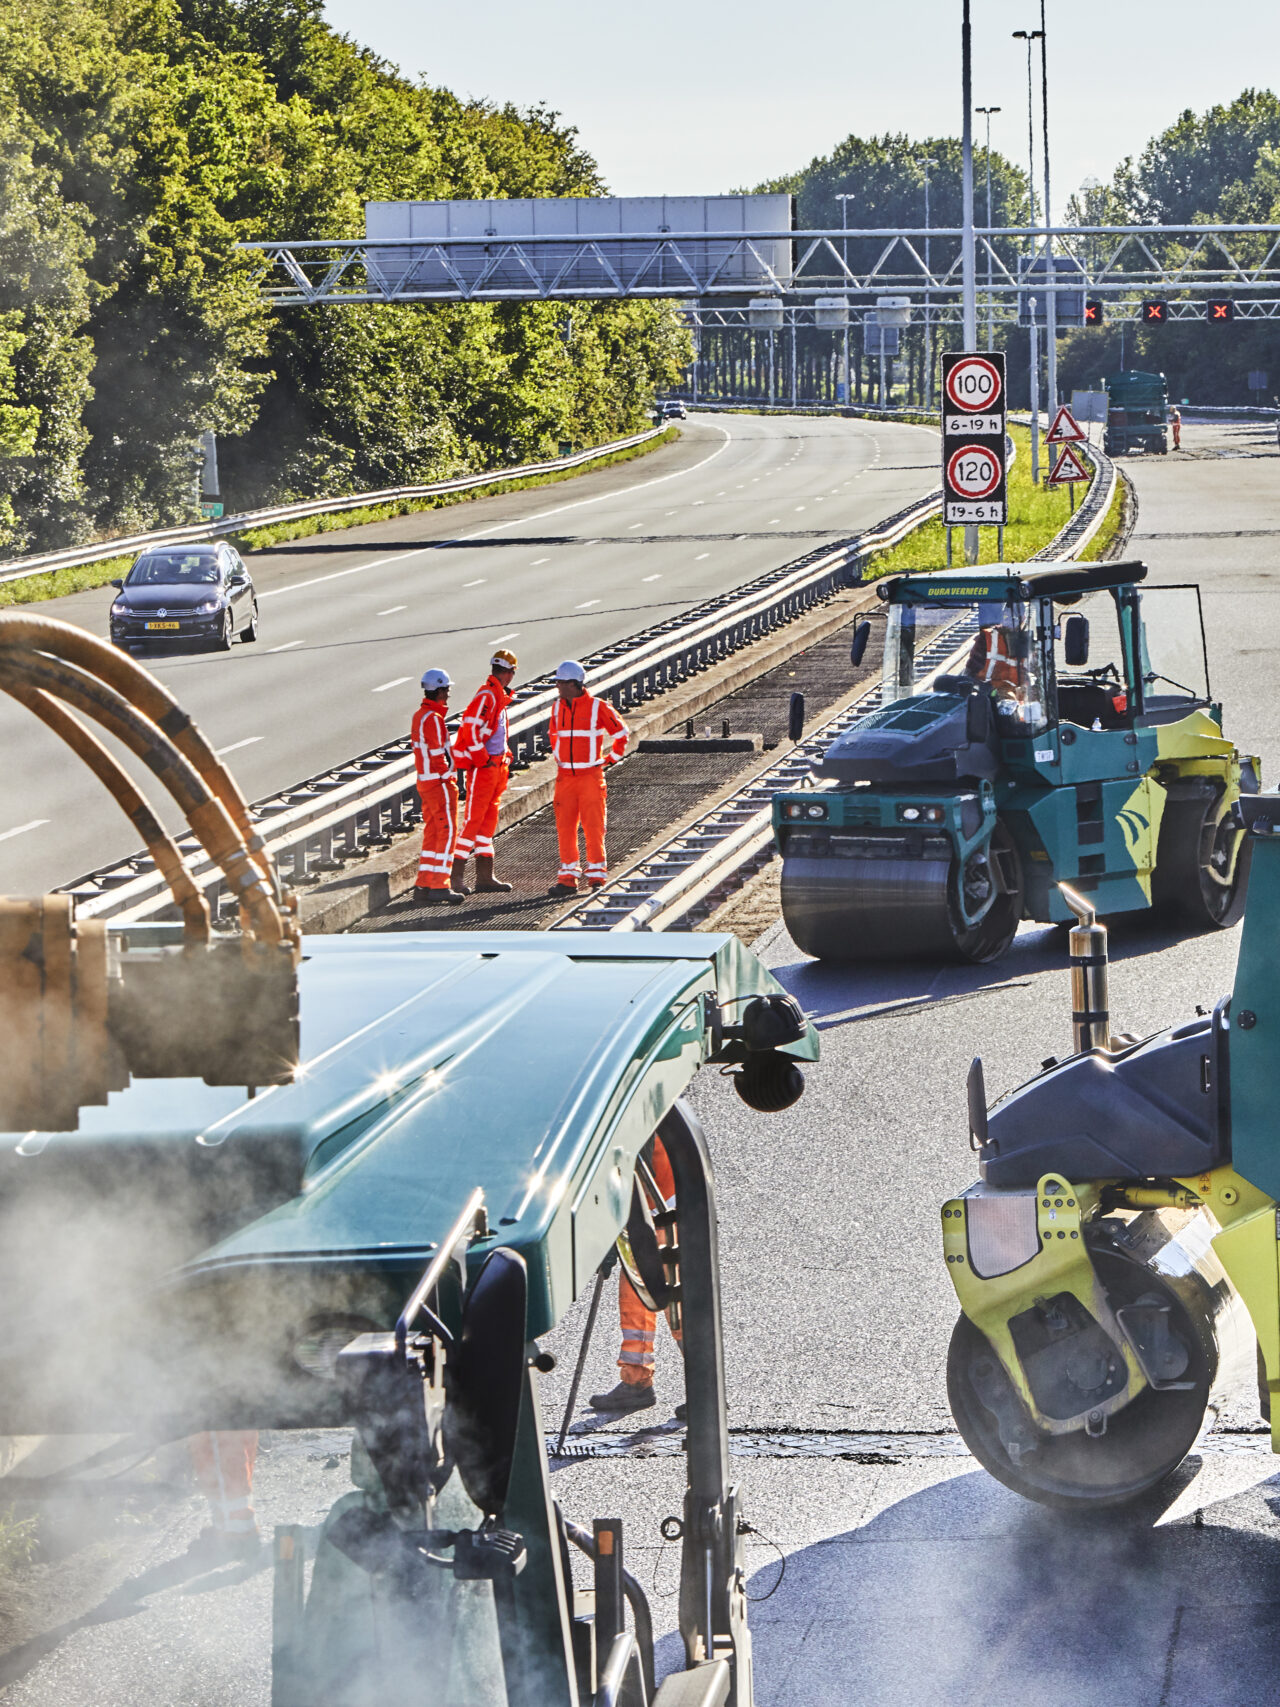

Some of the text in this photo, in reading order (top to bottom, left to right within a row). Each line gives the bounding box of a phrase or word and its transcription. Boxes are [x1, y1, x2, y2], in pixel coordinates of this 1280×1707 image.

[957, 375, 991, 393] 100
[951, 419, 997, 430] 6-19 h
[958, 461, 992, 481] 120
[952, 506, 998, 517] 19-6 h
